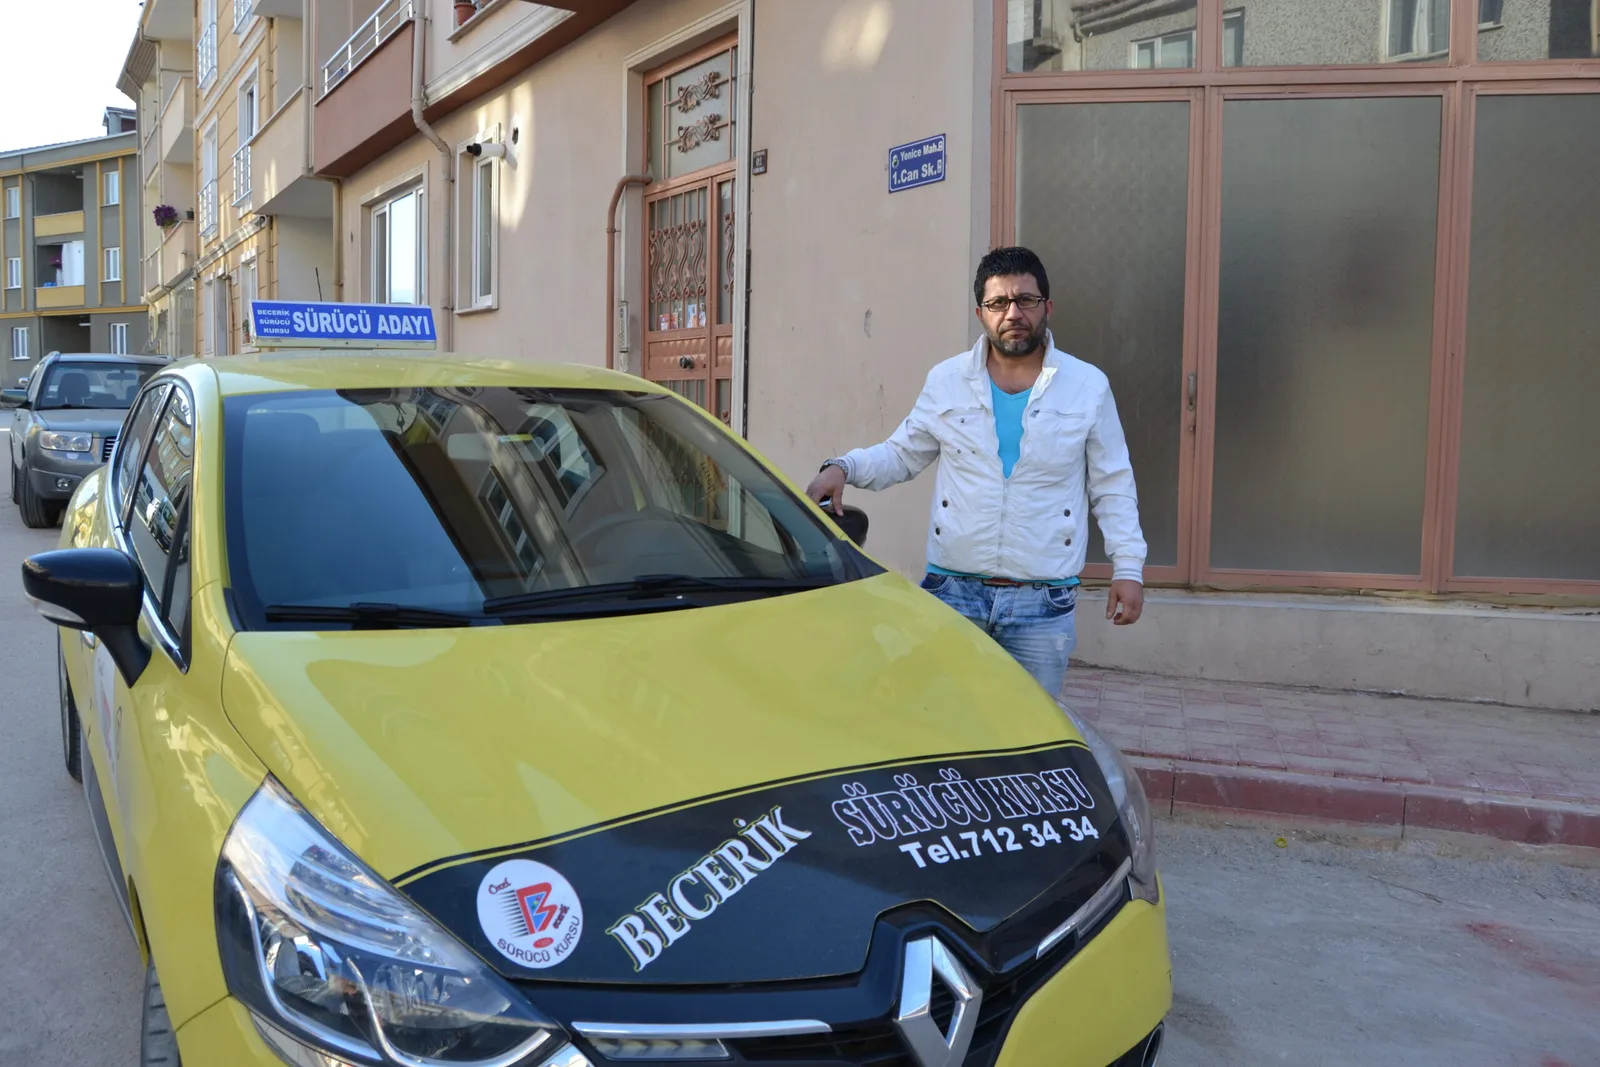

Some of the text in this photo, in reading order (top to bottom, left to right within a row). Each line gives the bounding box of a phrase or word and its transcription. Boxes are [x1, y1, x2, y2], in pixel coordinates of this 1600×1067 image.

[892, 169, 919, 185] 1.Can
[900, 148, 922, 161] Yenice
[292, 308, 430, 335] SÜRÜCÜ ADAYI
[831, 767, 1096, 846] SÜRÜCÜ KURSU
[898, 815, 1100, 870] Tel.712 34 34
[605, 805, 813, 973] BECERİK
[497, 916, 580, 963] SÜRÜCÜ KURSU
